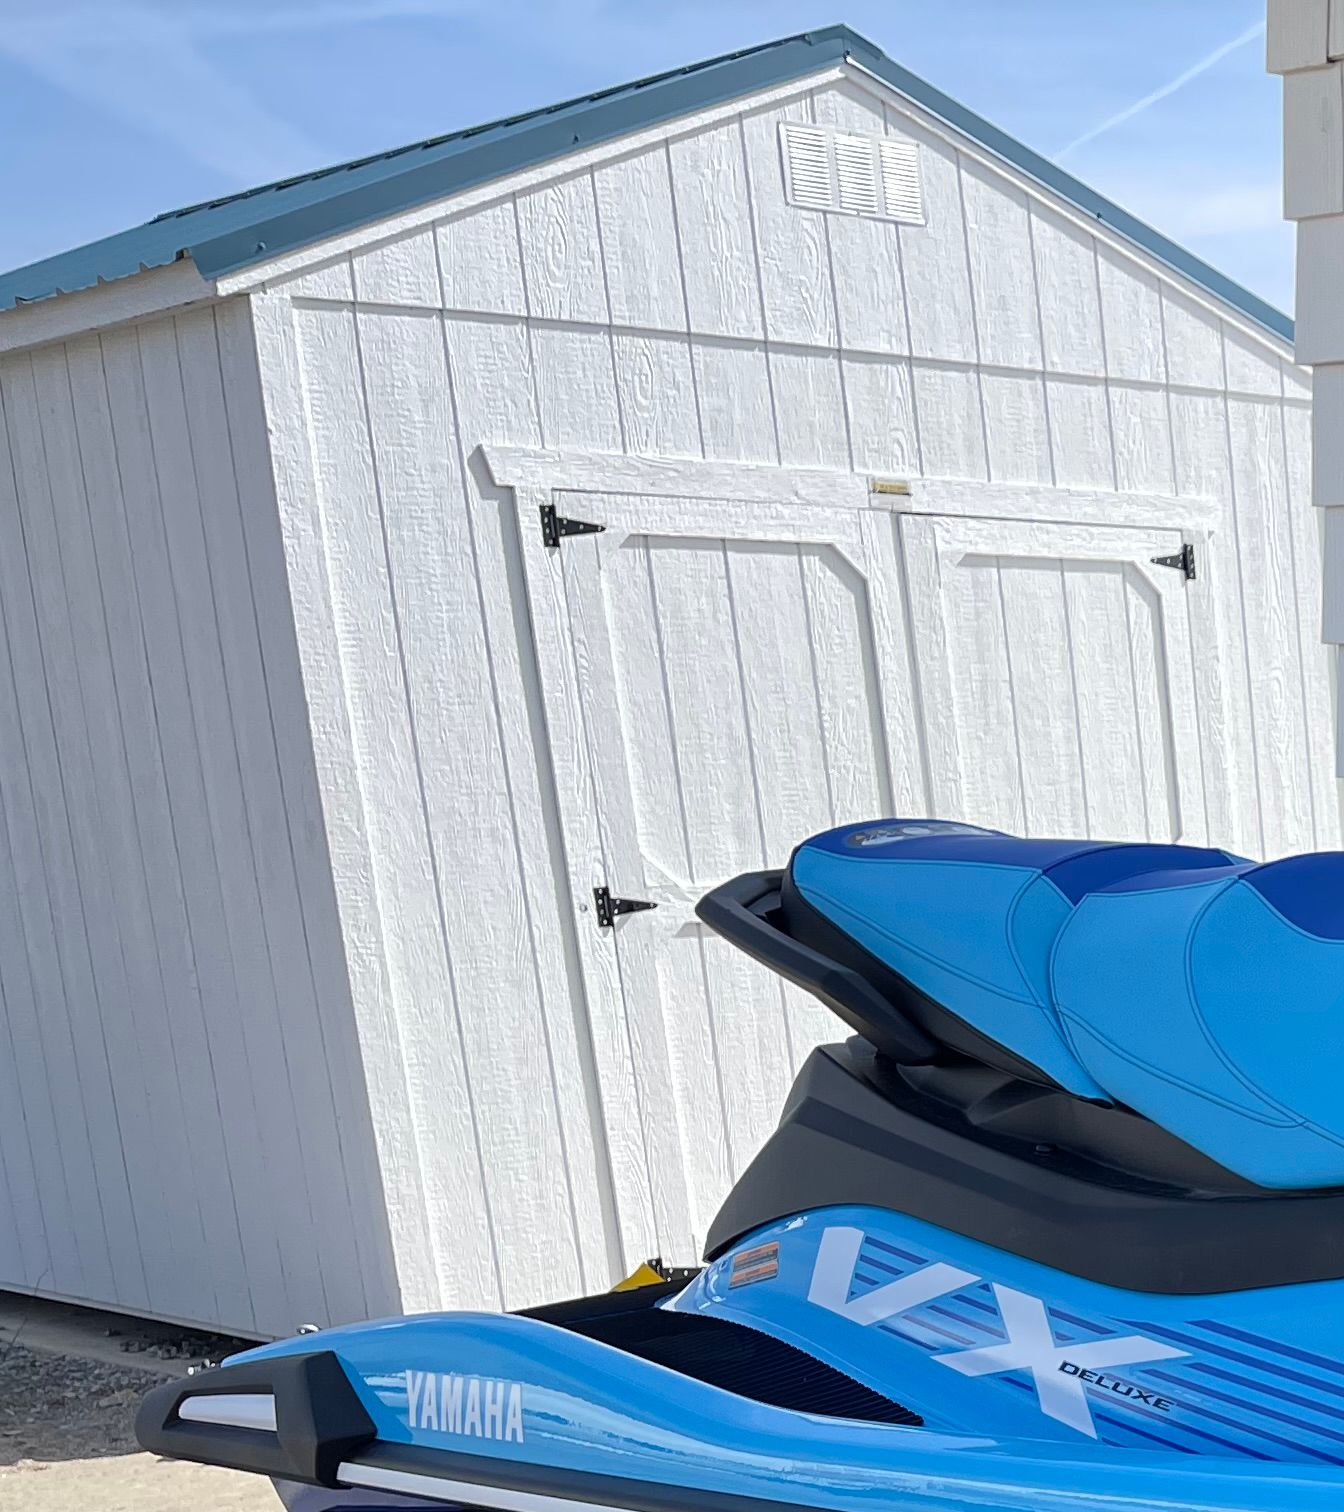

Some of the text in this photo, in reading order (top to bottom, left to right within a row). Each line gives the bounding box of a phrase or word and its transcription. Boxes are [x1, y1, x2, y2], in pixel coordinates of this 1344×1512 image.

[807, 1226, 1193, 1440] VX
[405, 1369, 524, 1443] YAMAHA
[1058, 1360, 1175, 1412] DELUXE
